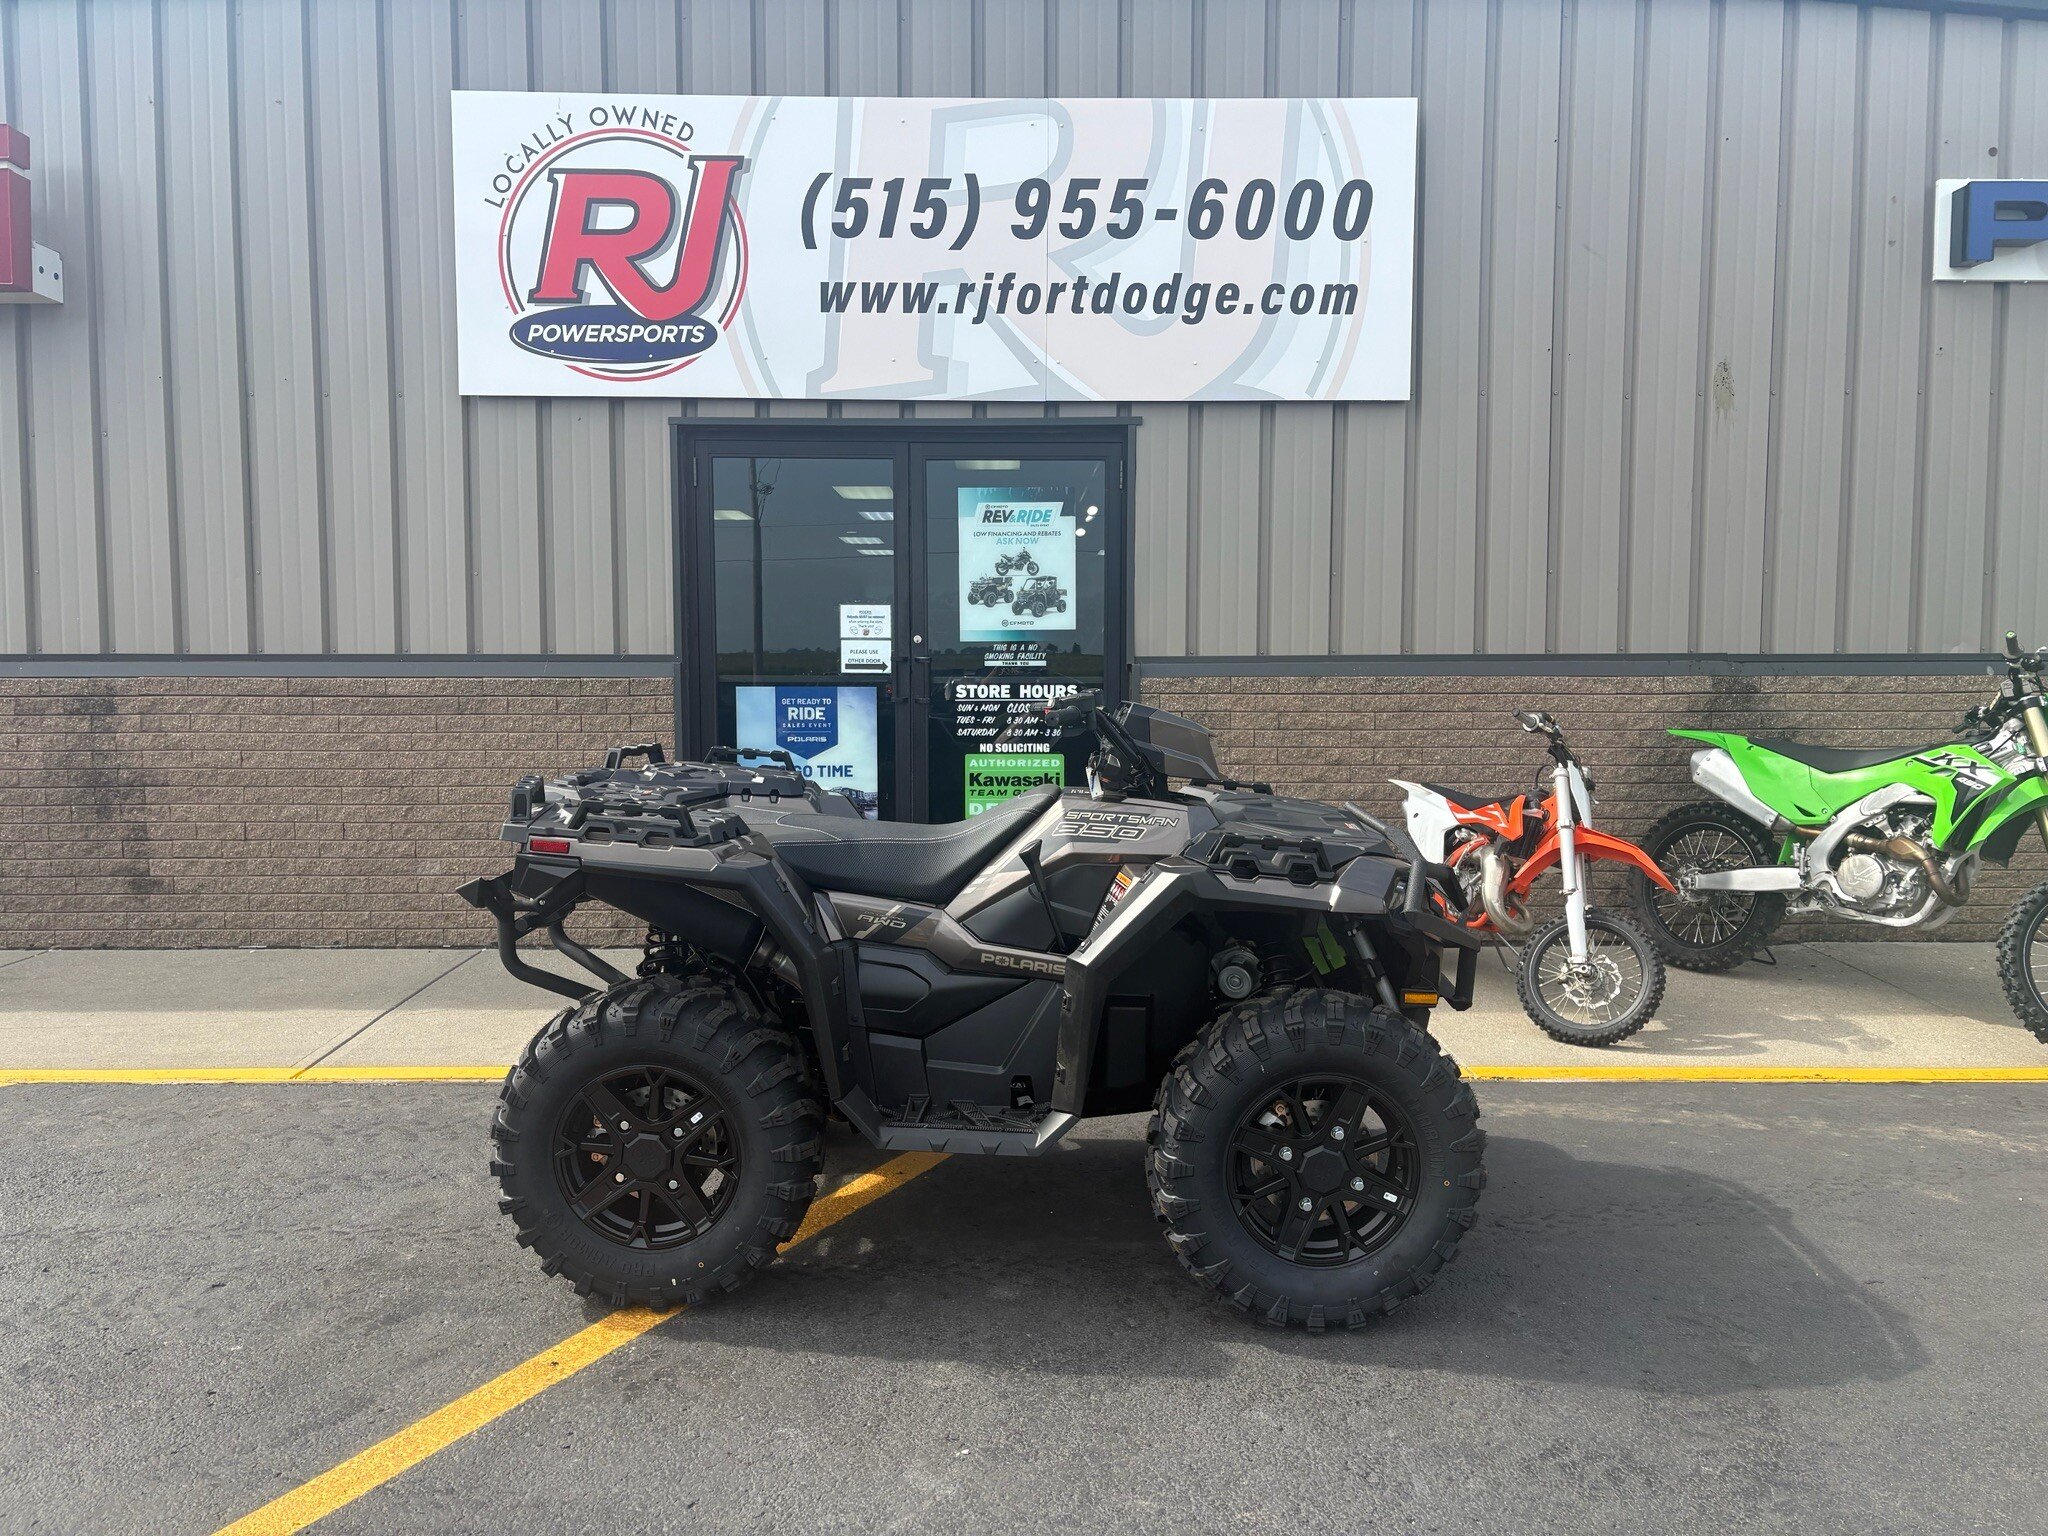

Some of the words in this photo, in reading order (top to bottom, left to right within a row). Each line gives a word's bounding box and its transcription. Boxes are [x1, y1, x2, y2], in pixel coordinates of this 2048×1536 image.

[484, 113, 572, 209] LOCALLY
[589, 105, 694, 142] OWNED
[800, 172, 981, 250] (515)
[1010, 178, 1374, 241] 955-6000
[527, 155, 748, 321] RJ
[820, 271, 1359, 325] www.rjfortdodge.com
[528, 322, 706, 343] POWERSPORTS
[984, 652, 1014, 660] SMOKING
[1017, 652, 1046, 660] FACILITY
[956, 684, 1010, 698] STORE
[1020, 684, 1078, 698] HOURS
[787, 706, 826, 721] RIDE
[956, 704, 973, 712] SUN
[980, 704, 1000, 712] MON
[1006, 703, 1031, 713] CLOS
[956, 716, 975, 724] TUES
[982, 716, 995, 724] FRI
[1023, 716, 1039, 724] AM
[956, 728, 999, 737] SATURDAY
[1023, 728, 1039, 737] AM
[980, 743, 993, 752] NO
[995, 743, 1050, 753] SOLICITING
[969, 759, 1060, 767] AUTHORIZED
[817, 765, 853, 778] TIME
[969, 772, 1060, 787] Kawasaki
[1956, 777, 1986, 790] 450
[969, 789, 1007, 797] TEAM
[1064, 811, 1179, 828] SPORTSMAN
[1051, 821, 1148, 841] 850
[857, 913, 907, 929] AWD
[980, 953, 1066, 976] POLARIS
